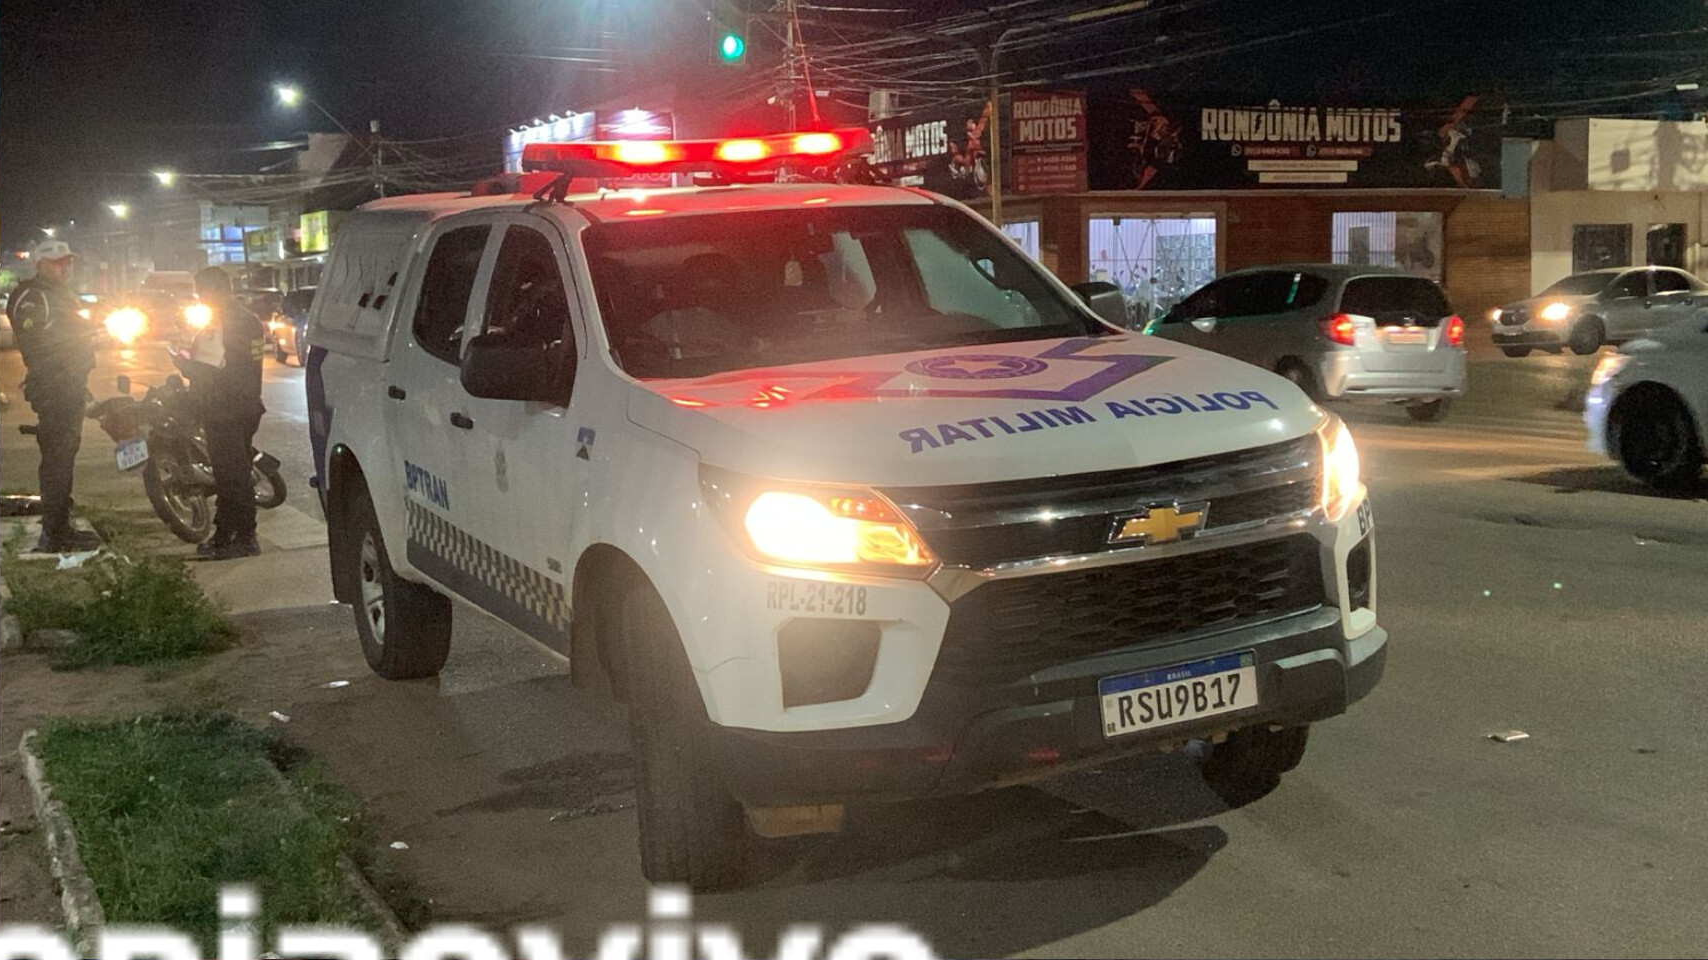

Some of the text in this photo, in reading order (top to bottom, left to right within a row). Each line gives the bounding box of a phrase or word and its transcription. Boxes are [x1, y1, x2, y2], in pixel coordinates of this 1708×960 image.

[1013, 95, 1082, 119] RONDÔNIA
[1202, 99, 1401, 142] RONDÔNIA MOTOS
[867, 120, 948, 165] ÔNIA MOTOS
[1019, 117, 1077, 142] MOTOS
[767, 580, 868, 616] RPL-21-218
[1167, 670, 1192, 681] BRASIL
[1118, 673, 1241, 729] RSU9B17
